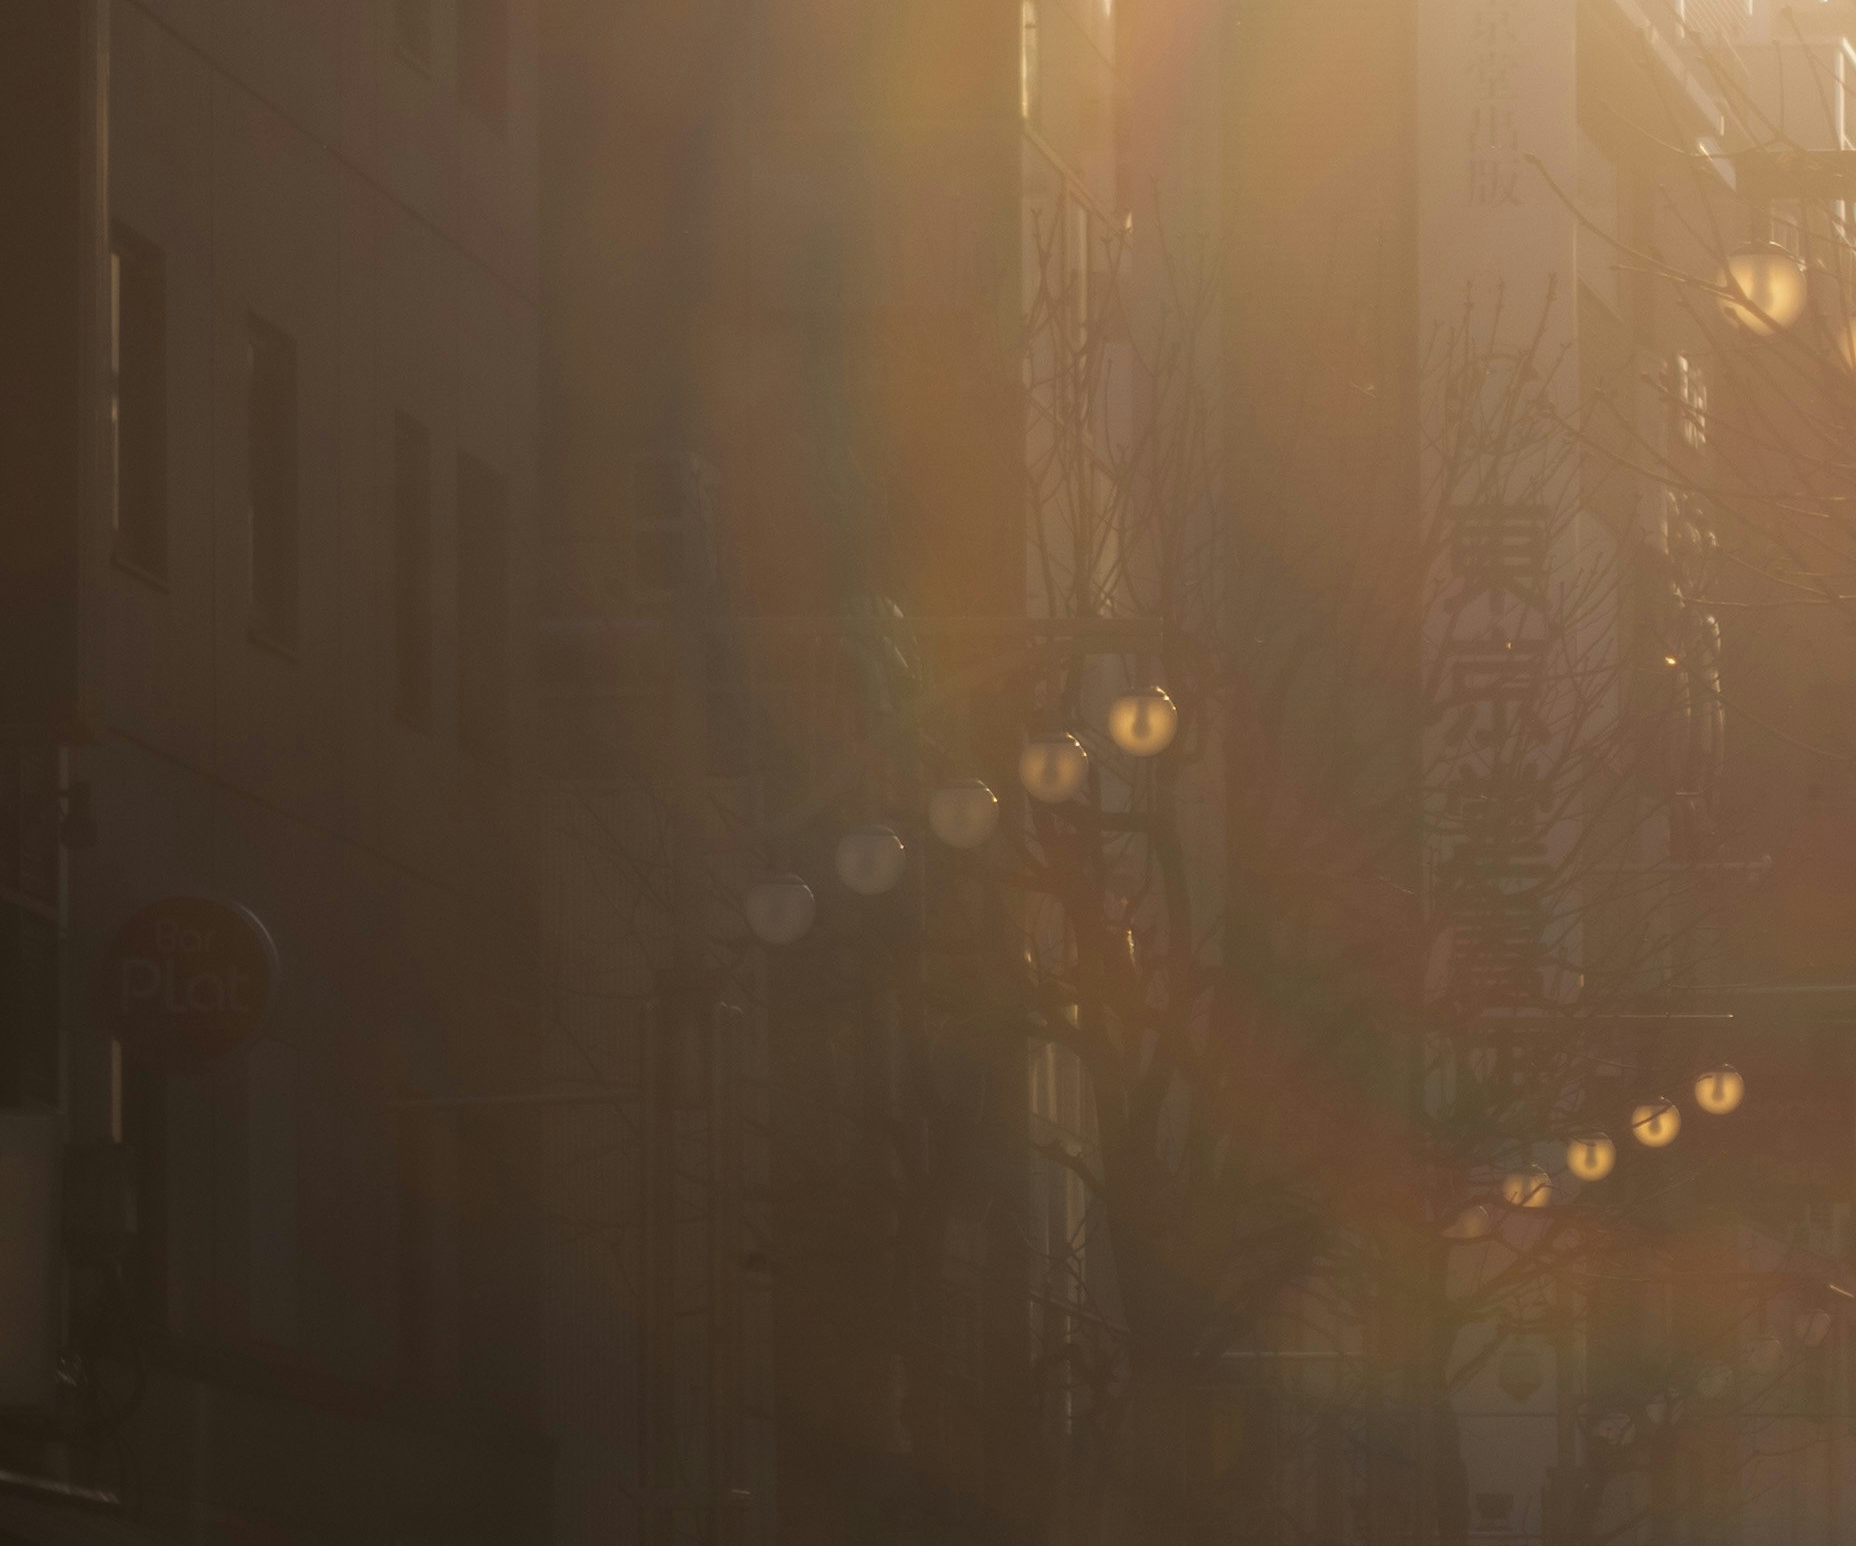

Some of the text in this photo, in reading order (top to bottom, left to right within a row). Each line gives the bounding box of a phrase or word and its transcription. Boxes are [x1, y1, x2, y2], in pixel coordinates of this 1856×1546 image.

[1442, 496, 1556, 1135] 東京堂書
[155, 917, 218, 955] Bar
[119, 957, 251, 1016] Plat
